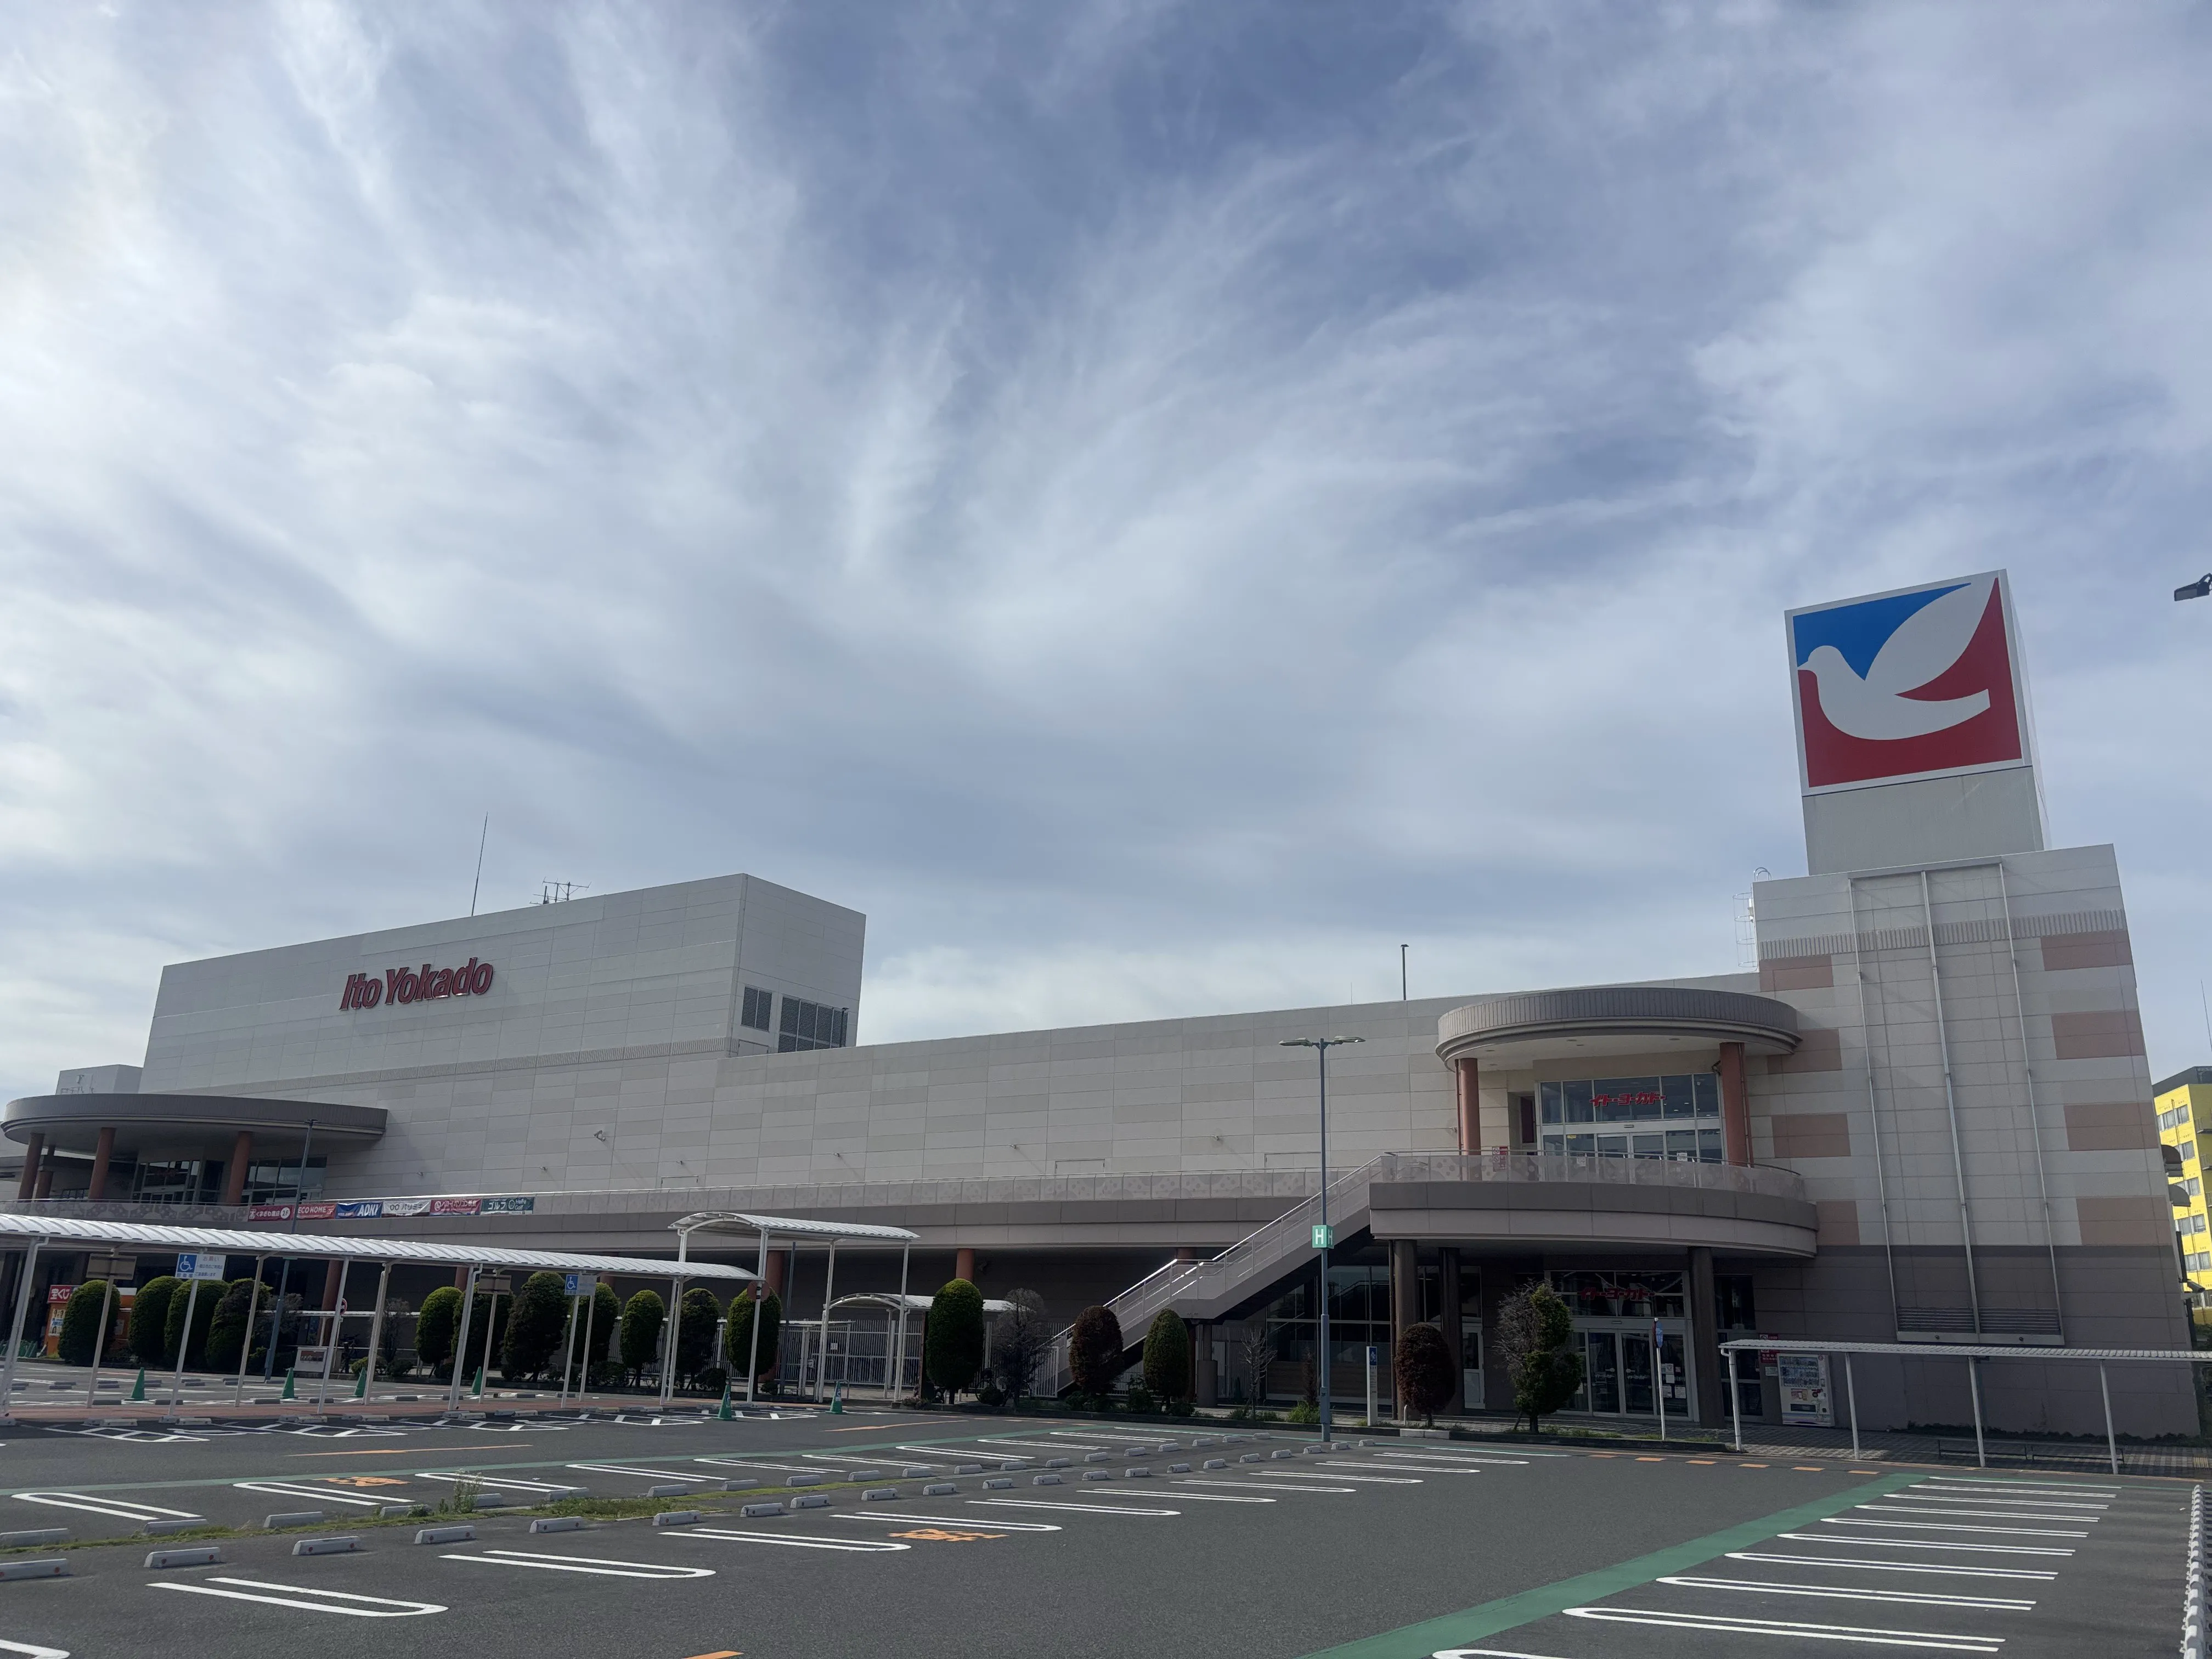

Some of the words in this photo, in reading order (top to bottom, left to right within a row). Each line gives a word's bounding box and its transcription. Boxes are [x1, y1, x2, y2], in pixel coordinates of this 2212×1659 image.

[339, 973, 382, 1011] Ito
[385, 957, 493, 1005] Yokado
[1589, 1091, 1666, 1107] イトーヨーカドー
[357, 1204, 379, 1216] AOKI
[488, 1201, 506, 1210] ゴルフ
[1315, 1228, 1324, 1245] H
[1328, 1229, 1333, 1245] H
[50, 1288, 70, 1300] 宝くじ
[1578, 1287, 1655, 1301] イトーヨーカドー
